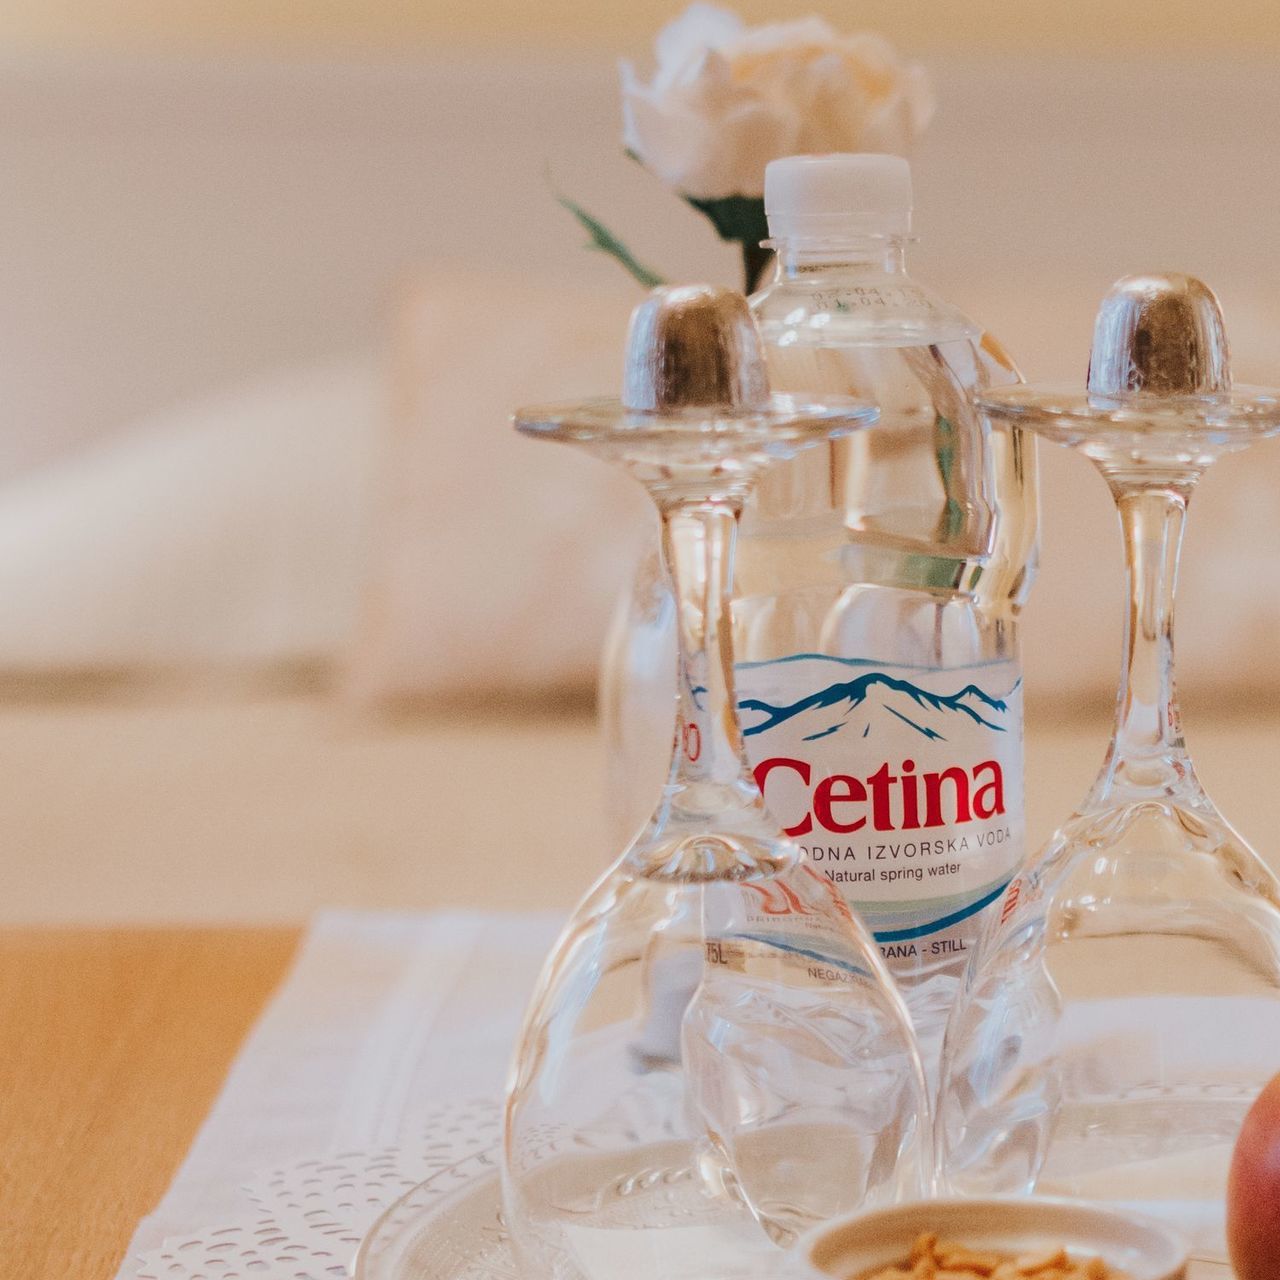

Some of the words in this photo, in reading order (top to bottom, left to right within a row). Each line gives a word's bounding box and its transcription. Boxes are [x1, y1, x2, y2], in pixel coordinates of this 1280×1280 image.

[752, 757, 1006, 838] Cetina
[868, 837, 969, 860] IZVORSKA
[976, 827, 1011, 847] VODA
[825, 868, 875, 882] Natural
[880, 867, 923, 882] spring
[927, 863, 961, 877] water
[880, 944, 917, 959] RANA
[931, 938, 967, 955] STILL
